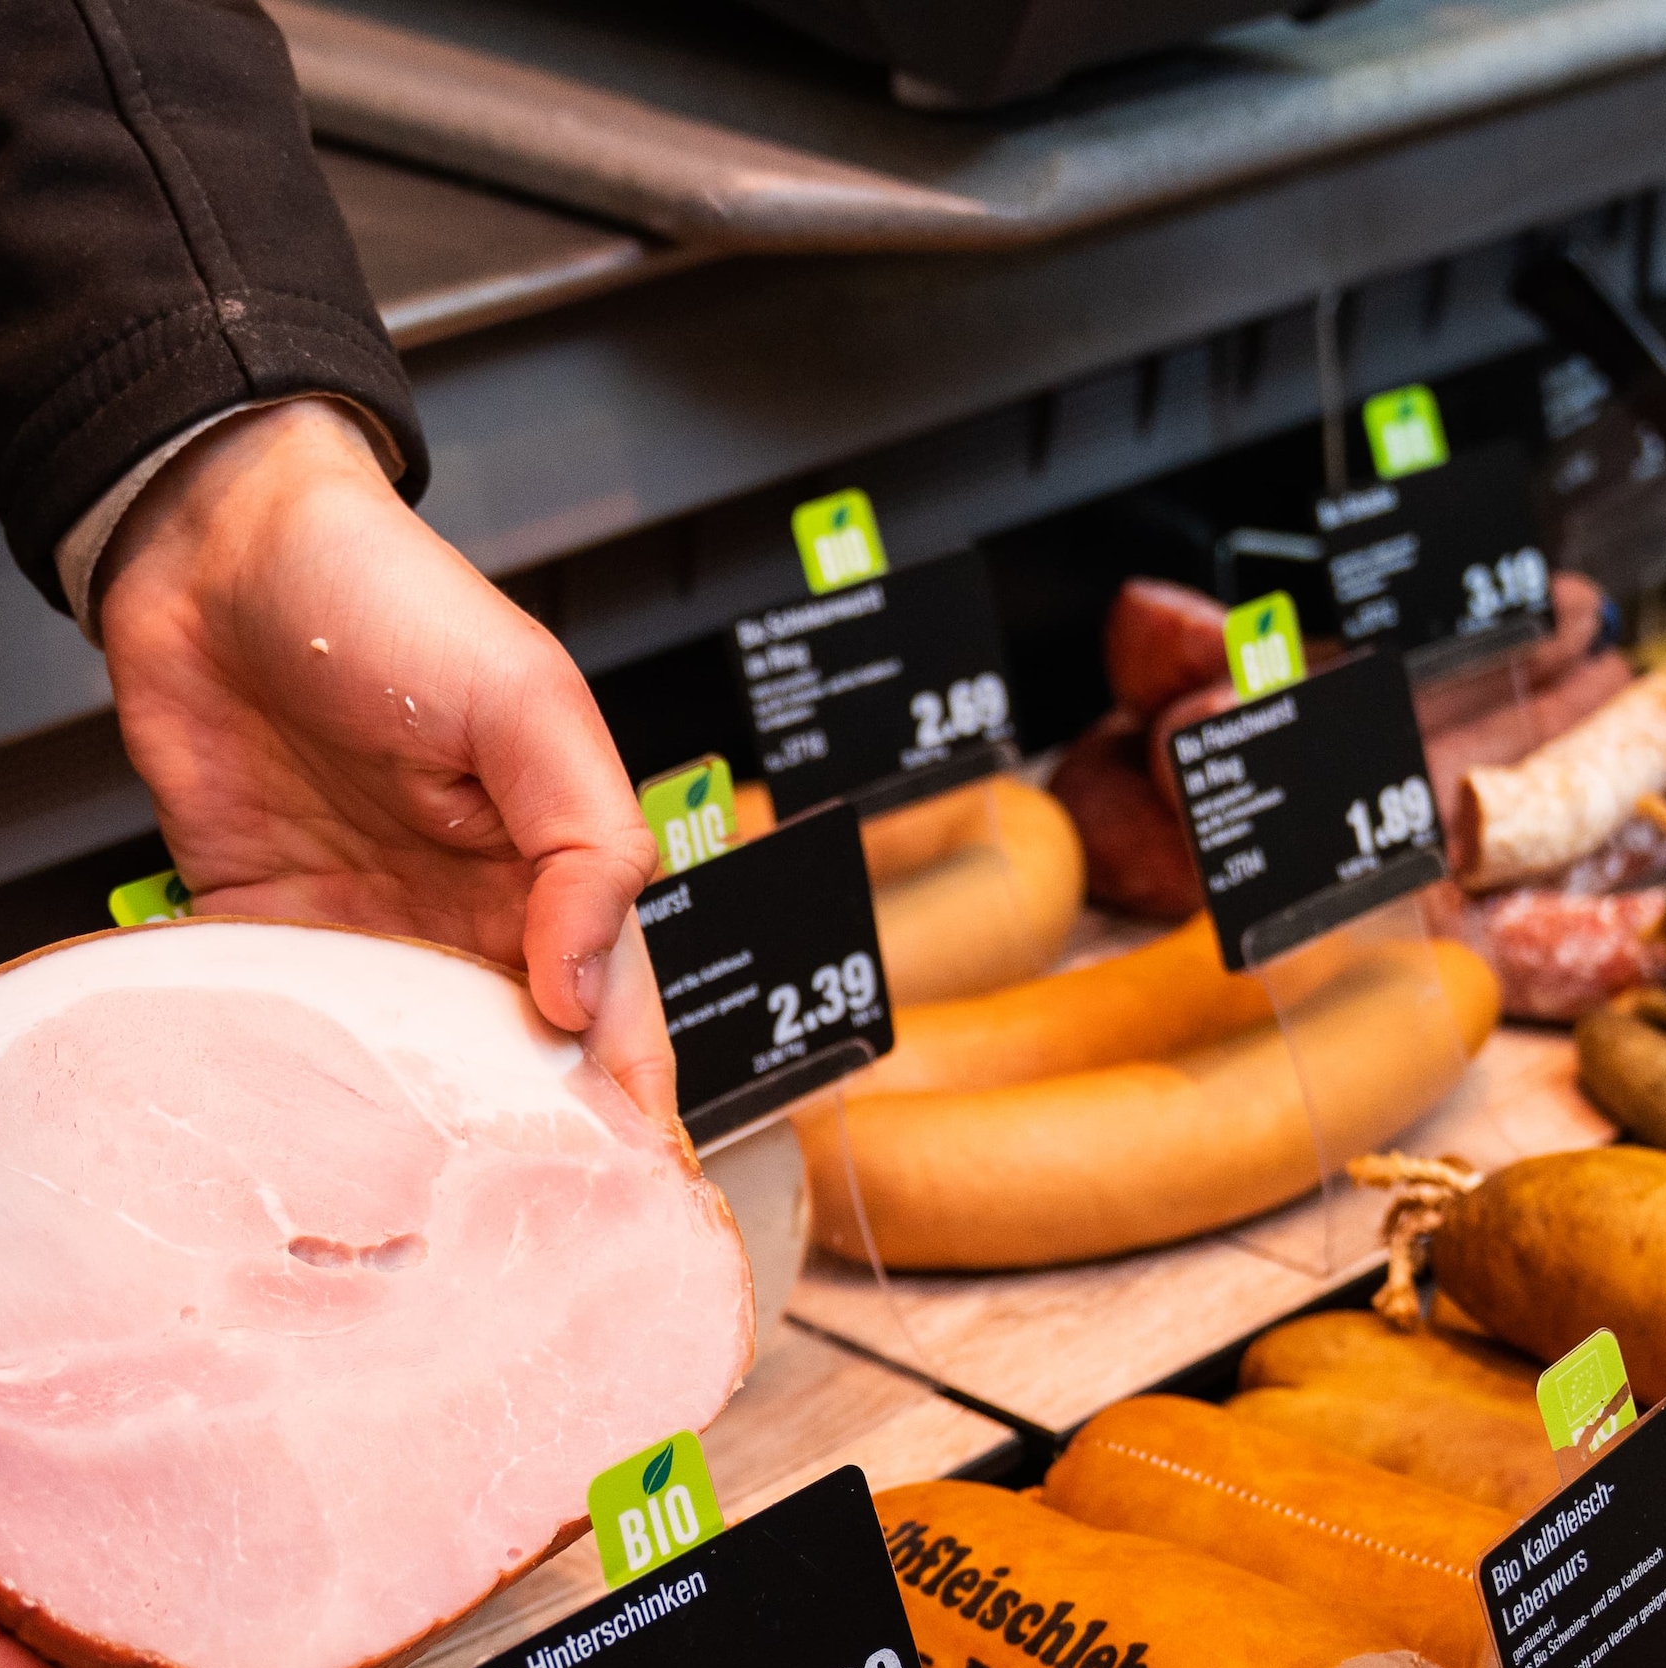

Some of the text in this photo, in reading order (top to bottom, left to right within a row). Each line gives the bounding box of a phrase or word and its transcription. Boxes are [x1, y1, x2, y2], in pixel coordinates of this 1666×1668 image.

[813, 526, 873, 585] BIO
[1241, 633, 1292, 693] BIO
[664, 803, 727, 872] BIO
[1345, 774, 1433, 856] 1.89
[767, 950, 878, 1047] 2.39
[618, 1484, 701, 1573] BIO
[1491, 1481, 1616, 1597] Bio Kalbfleisch-
[1501, 1549, 1589, 1636] Leberwurs
[1533, 1648, 1548, 1667] Bio
[1548, 1613, 1590, 1656] Schweine-
[1591, 1599, 1607, 1619] und
[1607, 1586, 1621, 1605] Bio
[1621, 1546, 1664, 1591] Kalbfleisch
[1512, 1615, 1558, 1666] geräuchert
[1591, 1643, 1610, 1664] zum
[1608, 1614, 1639, 1646] Verzehr
